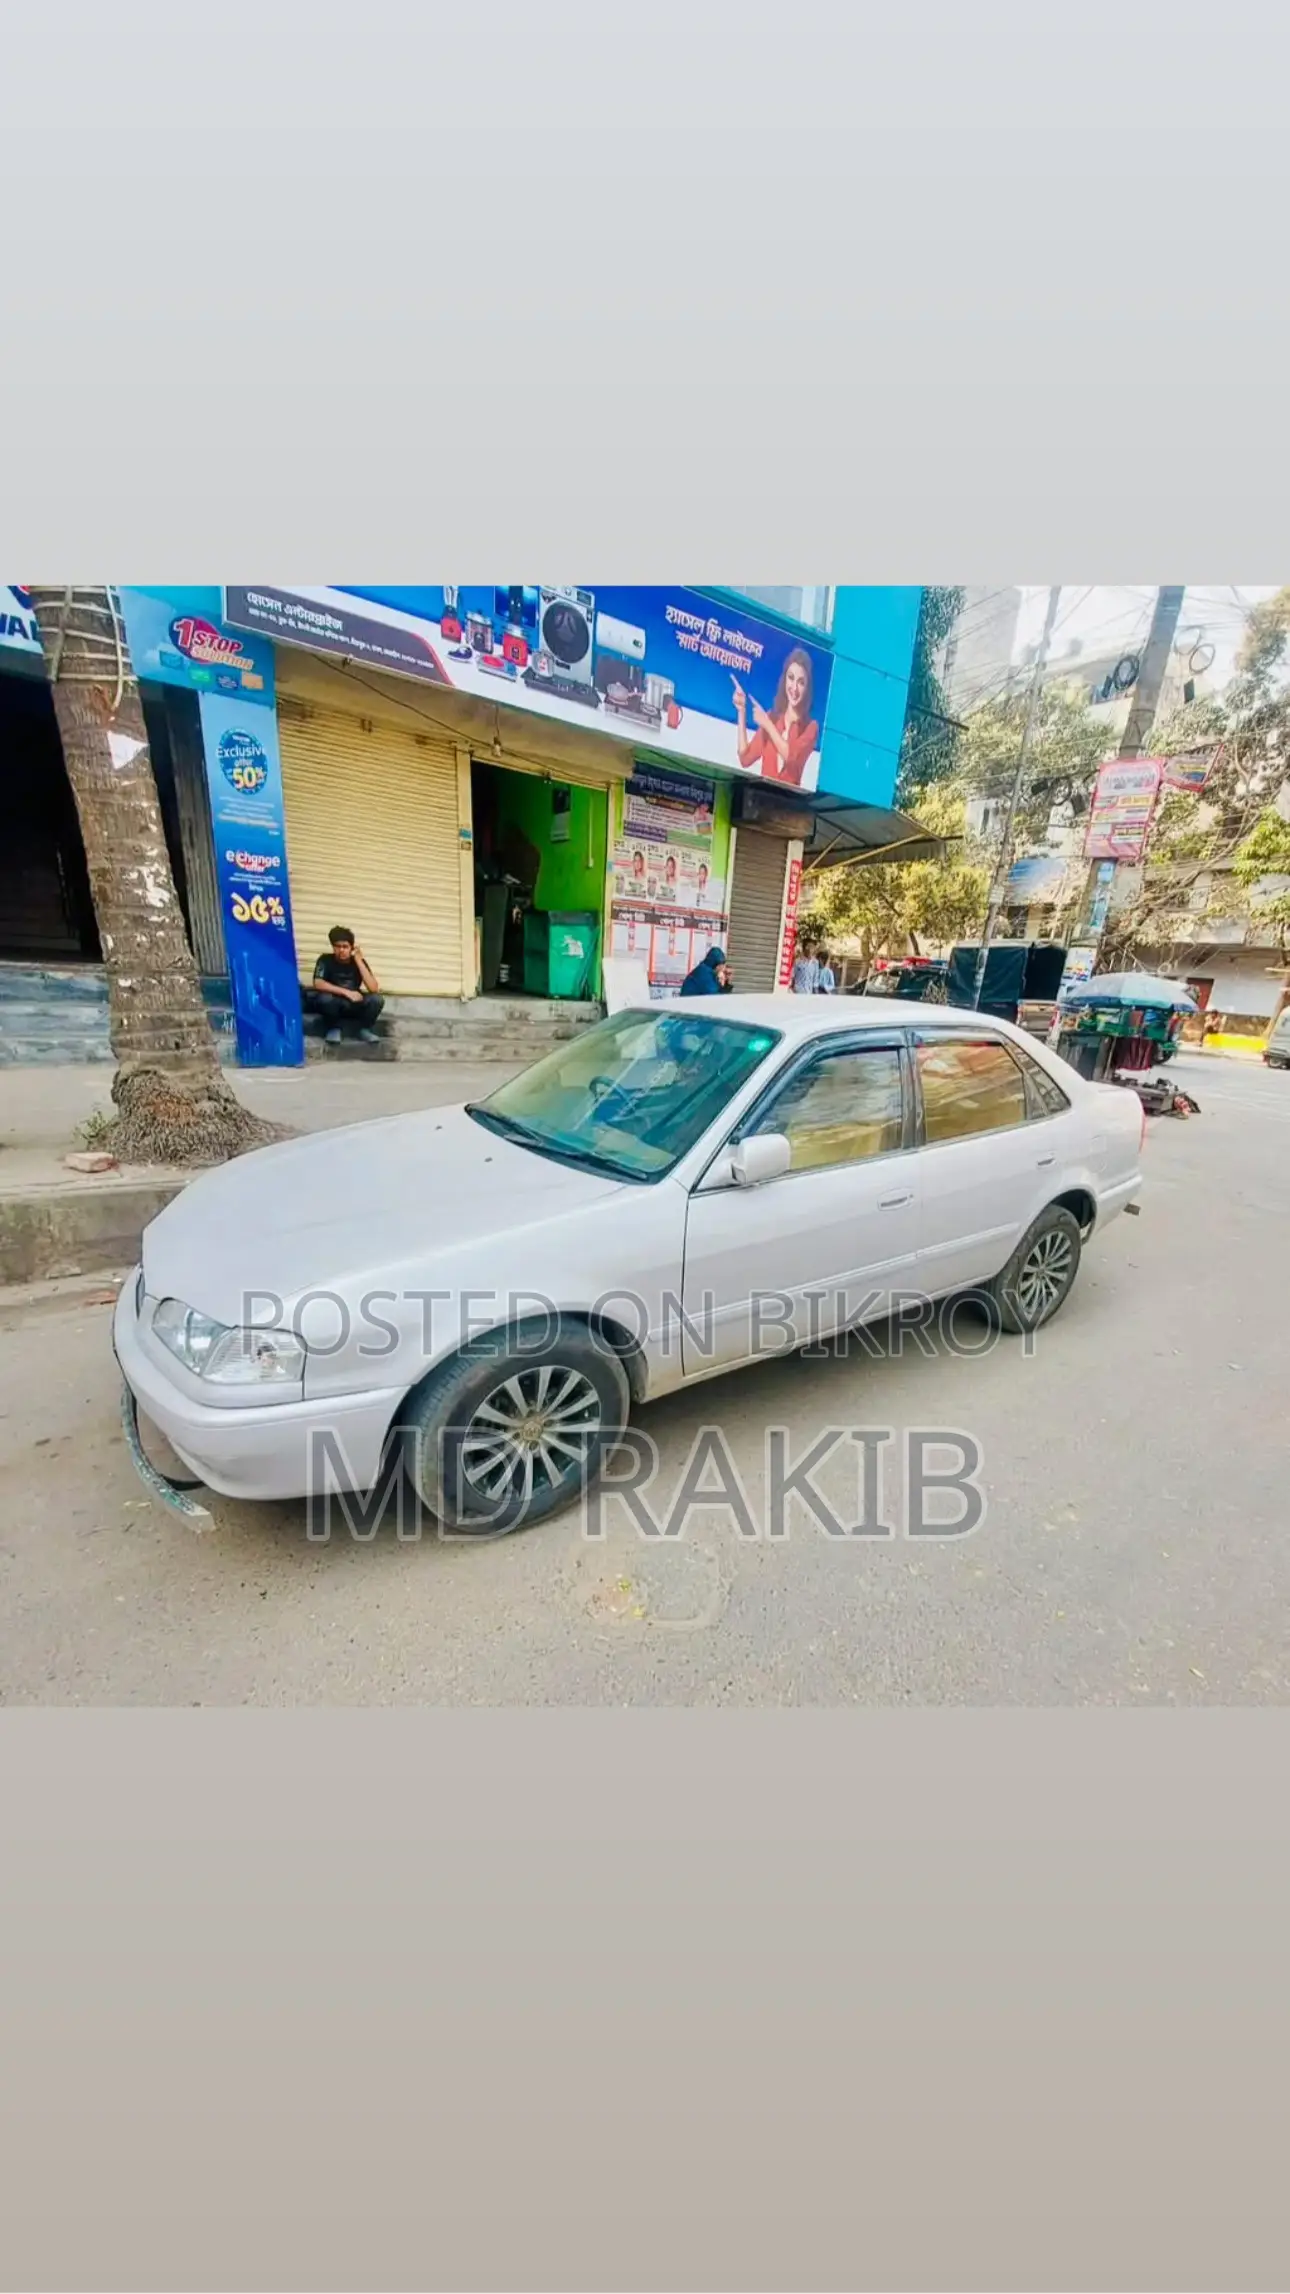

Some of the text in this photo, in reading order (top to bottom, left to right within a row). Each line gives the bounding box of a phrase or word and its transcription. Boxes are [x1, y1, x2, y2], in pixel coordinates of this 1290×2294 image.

[173, 618, 244, 655] 1 STOP
[230, 891, 285, 925] ১৫%
